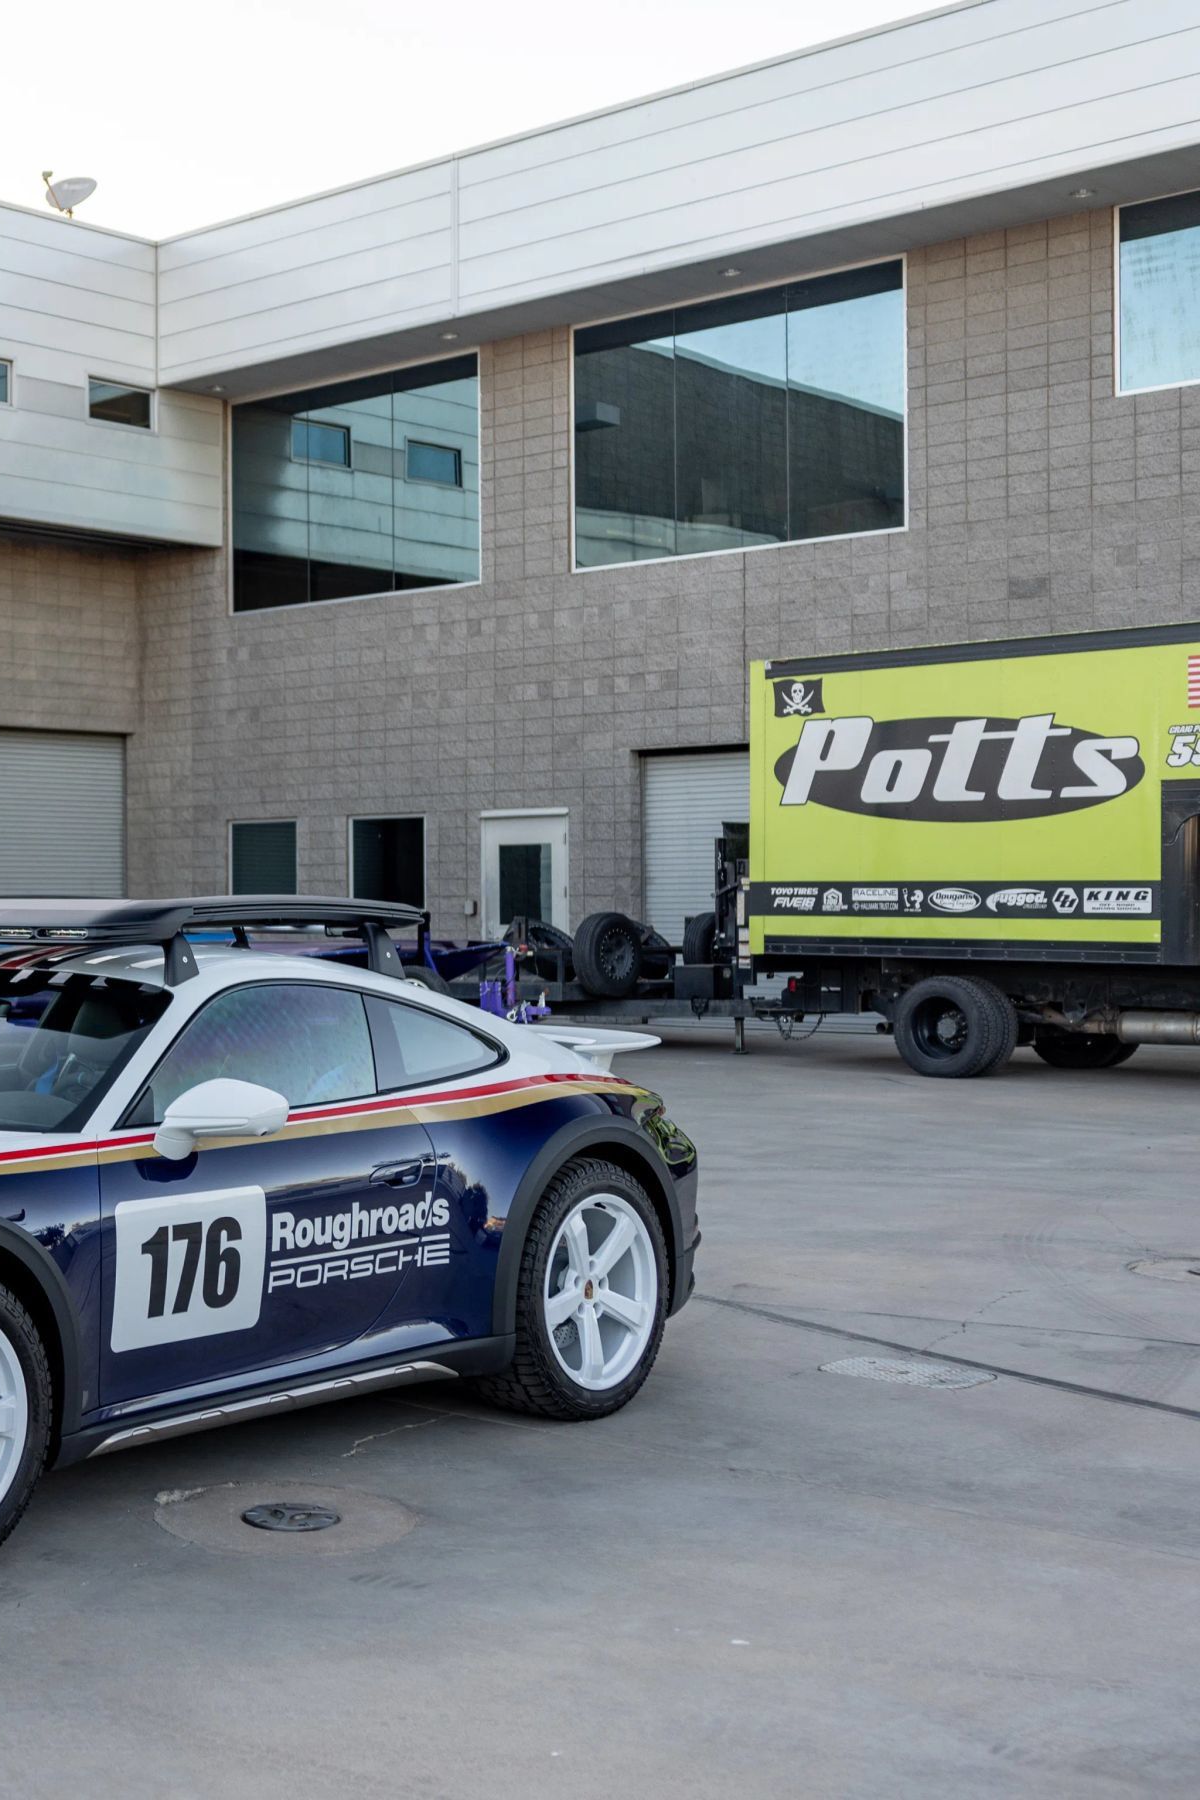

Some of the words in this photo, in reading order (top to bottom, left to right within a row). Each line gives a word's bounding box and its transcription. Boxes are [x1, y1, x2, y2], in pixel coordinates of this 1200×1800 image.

[779, 712, 1139, 806] Potts
[853, 889, 897, 897] RACELINE
[1086, 890, 1149, 901] KING
[271, 1191, 449, 1252] Roughroads
[141, 1216, 242, 1319] 176
[268, 1243, 450, 1293] PORSCHE
